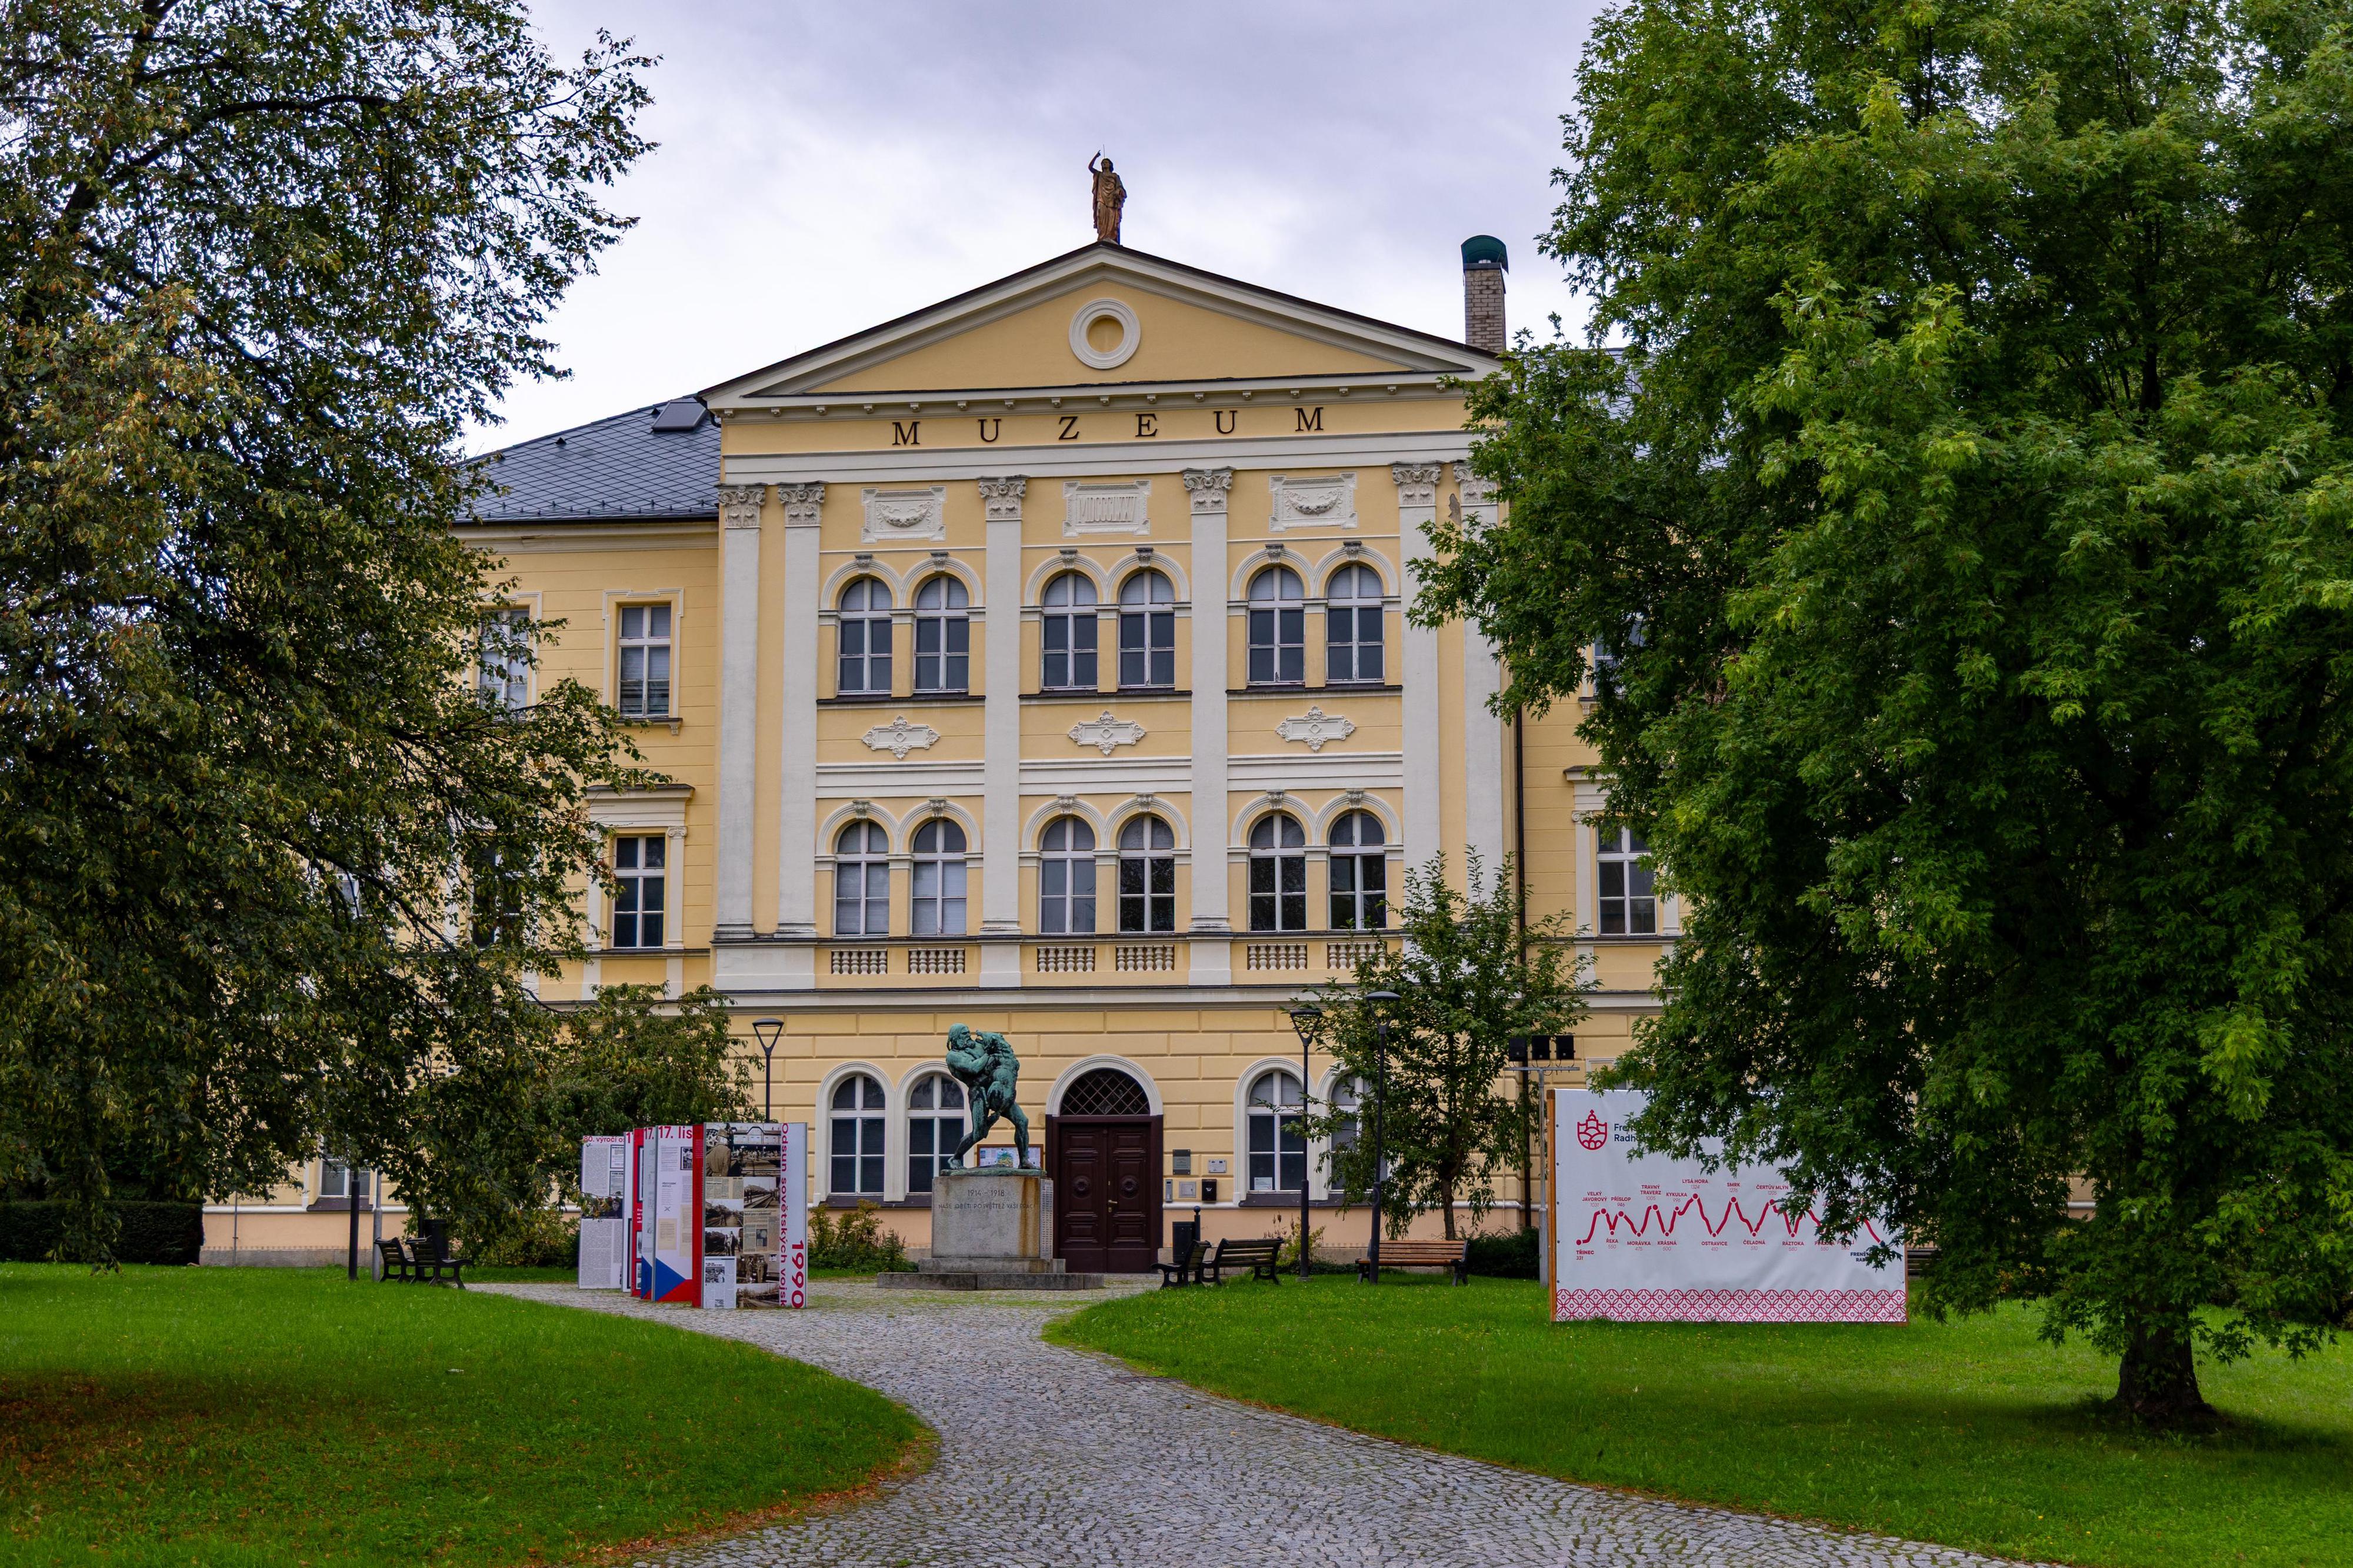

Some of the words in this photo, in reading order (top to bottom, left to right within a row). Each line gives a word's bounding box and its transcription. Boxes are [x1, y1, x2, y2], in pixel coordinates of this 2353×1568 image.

[892, 407, 1324, 445] MUZEUM
[644, 1127, 654, 1140] 17.
[658, 1126, 674, 1139] 17.
[779, 1177, 788, 1263] sovětských
[779, 1268, 788, 1307] vojsk
[791, 1239, 804, 1309] 1990
